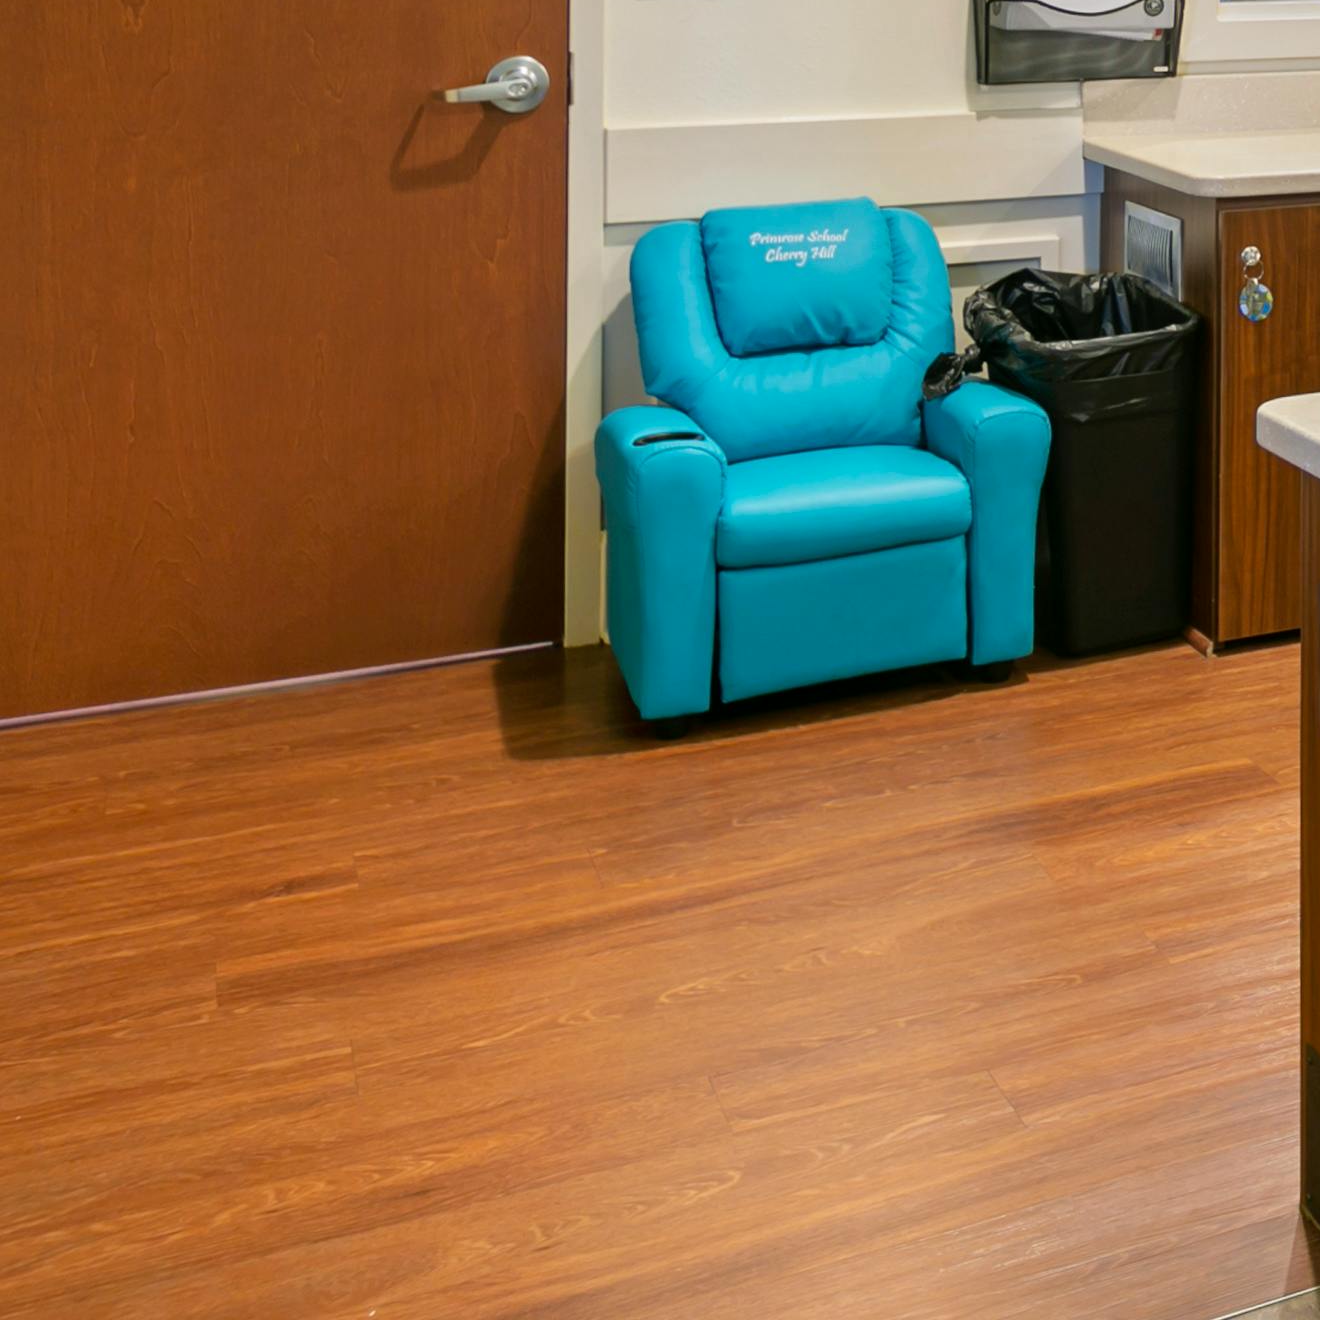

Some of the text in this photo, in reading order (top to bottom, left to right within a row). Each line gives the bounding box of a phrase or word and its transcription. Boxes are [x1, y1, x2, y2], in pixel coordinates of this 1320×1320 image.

[750, 229, 849, 246] Primrose School
[764, 245, 836, 268] Cherry Hill
